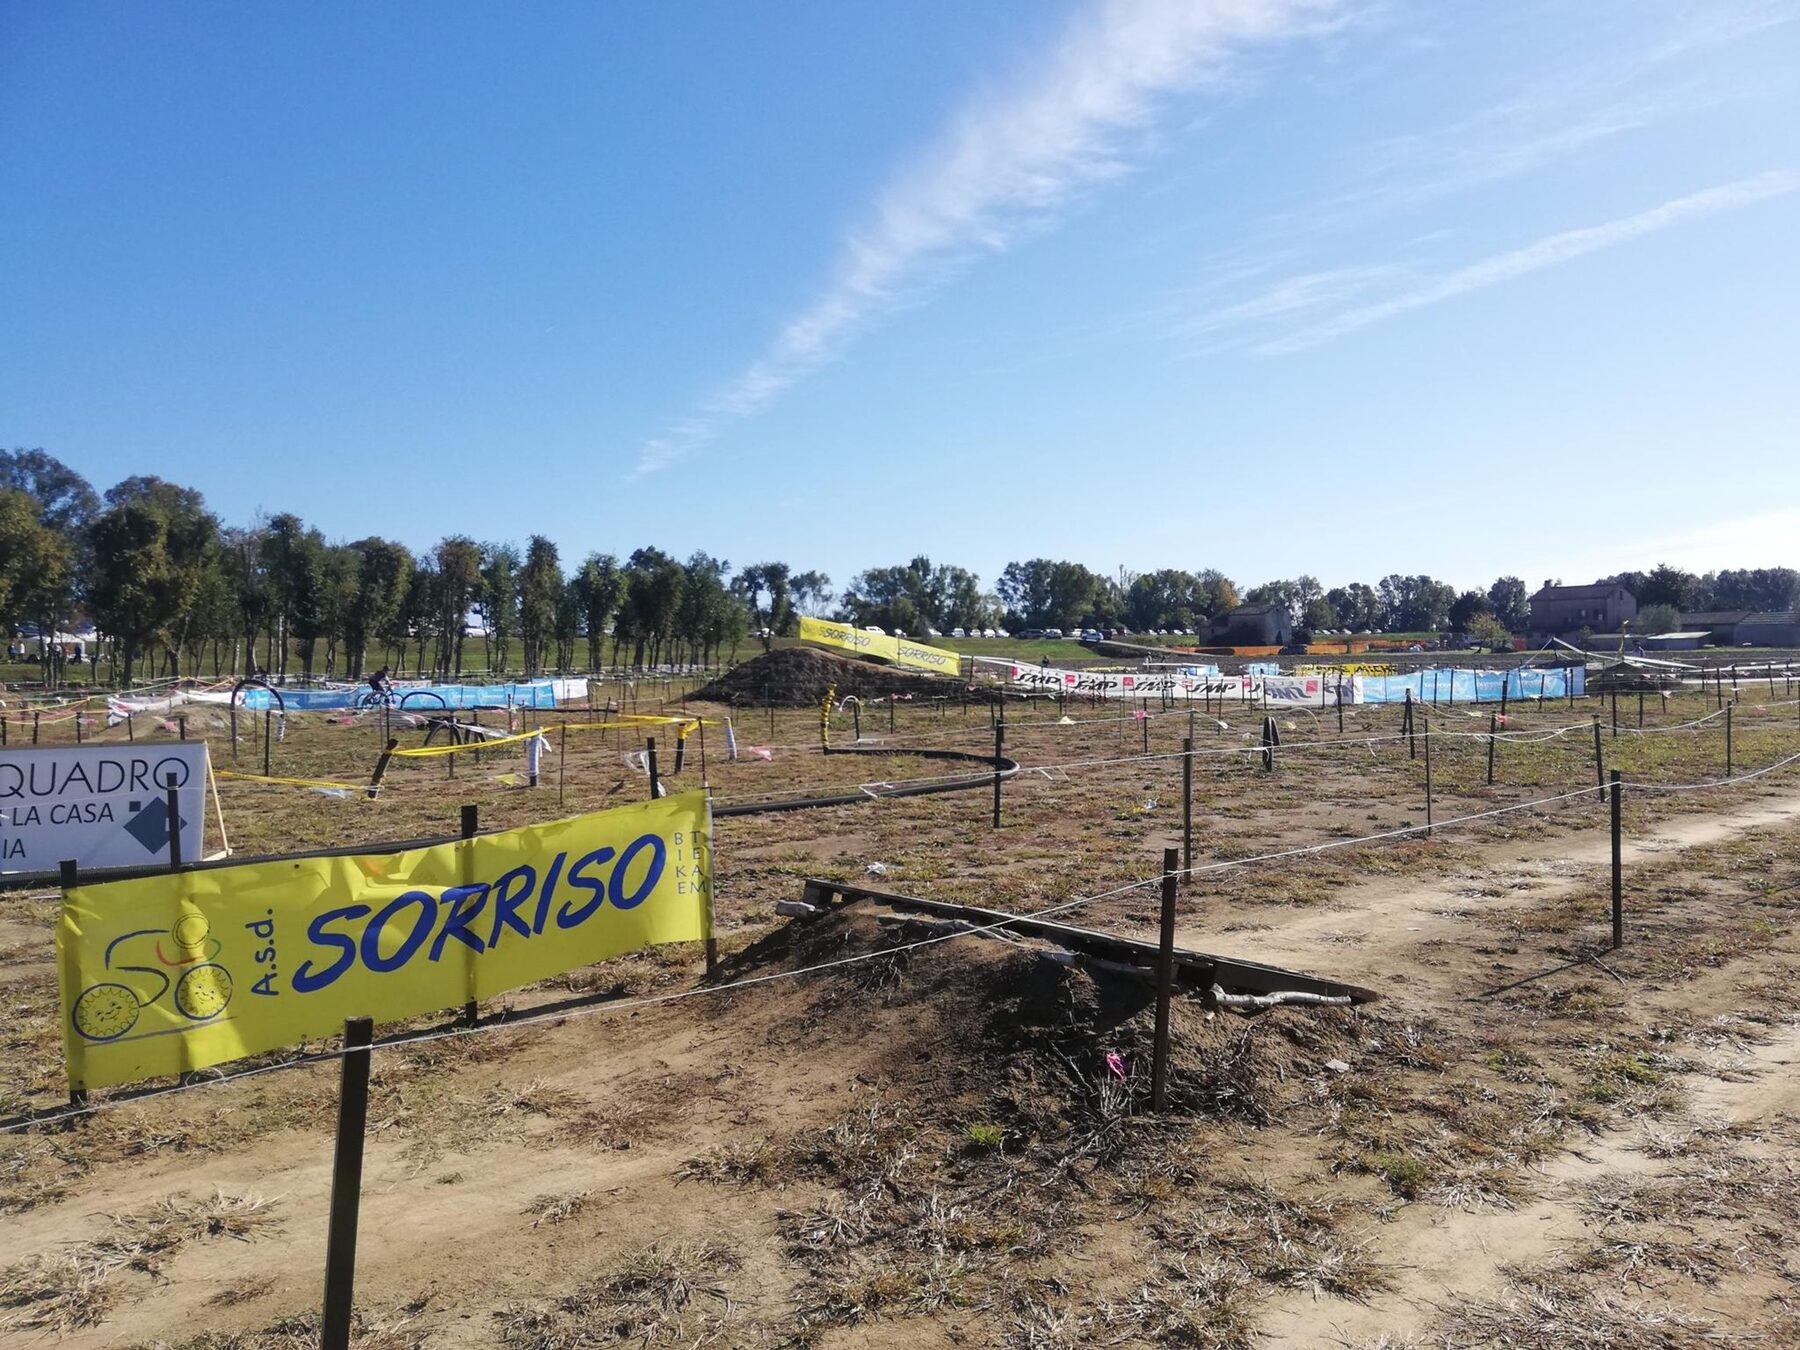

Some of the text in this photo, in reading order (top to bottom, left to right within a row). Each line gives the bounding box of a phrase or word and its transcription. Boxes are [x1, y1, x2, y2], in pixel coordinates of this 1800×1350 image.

[822, 627, 871, 647] SORRISO
[897, 646, 946, 666] SORRISO
[1187, 682, 1237, 693] SMP
[0, 757, 190, 799] QUADRO
[12, 805, 42, 827] LA
[50, 802, 115, 825] CASA
[674, 831, 688, 895] BIKE
[689, 830, 707, 894] TEAM
[291, 832, 667, 994] SORRISO
[244, 908, 280, 996] A.s.d.
